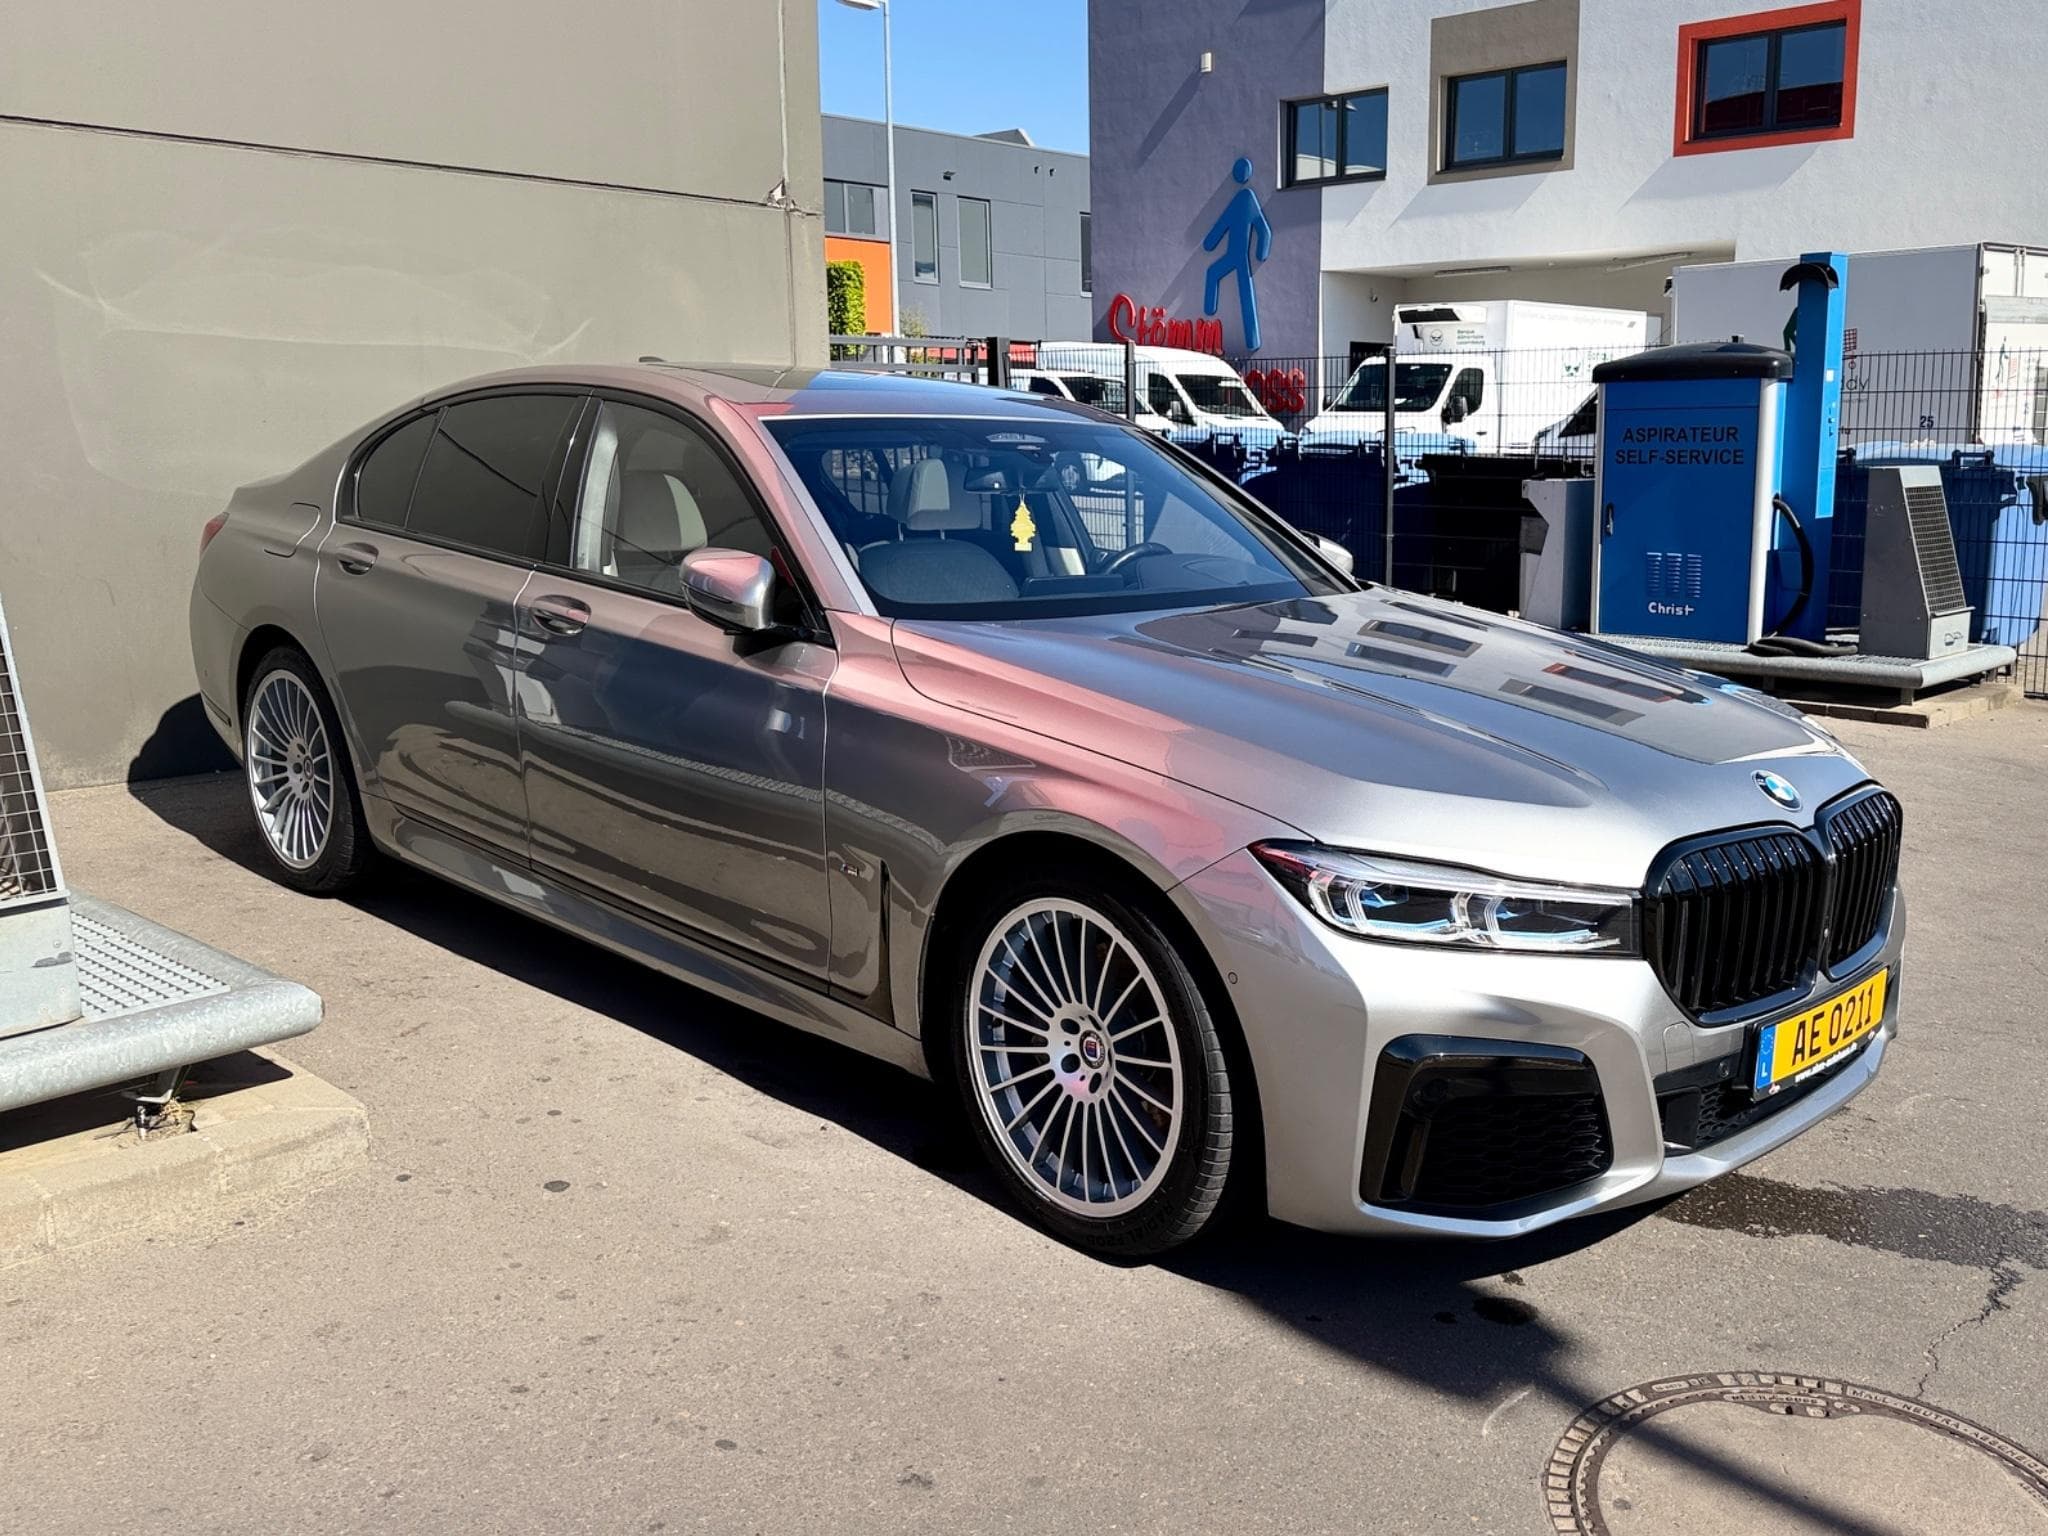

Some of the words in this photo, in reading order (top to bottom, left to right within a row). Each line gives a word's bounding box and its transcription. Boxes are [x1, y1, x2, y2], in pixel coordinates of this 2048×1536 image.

[1919, 415, 1935, 429] 25
[1622, 425, 1739, 443] ASPIRATEUR
[1615, 448, 1744, 465] SELF-SERVICE
[1647, 601, 1695, 616] Christ
[1792, 1011, 1825, 1066] AE
[1828, 984, 1874, 1046] 0211
[1761, 1062, 1768, 1078] L
